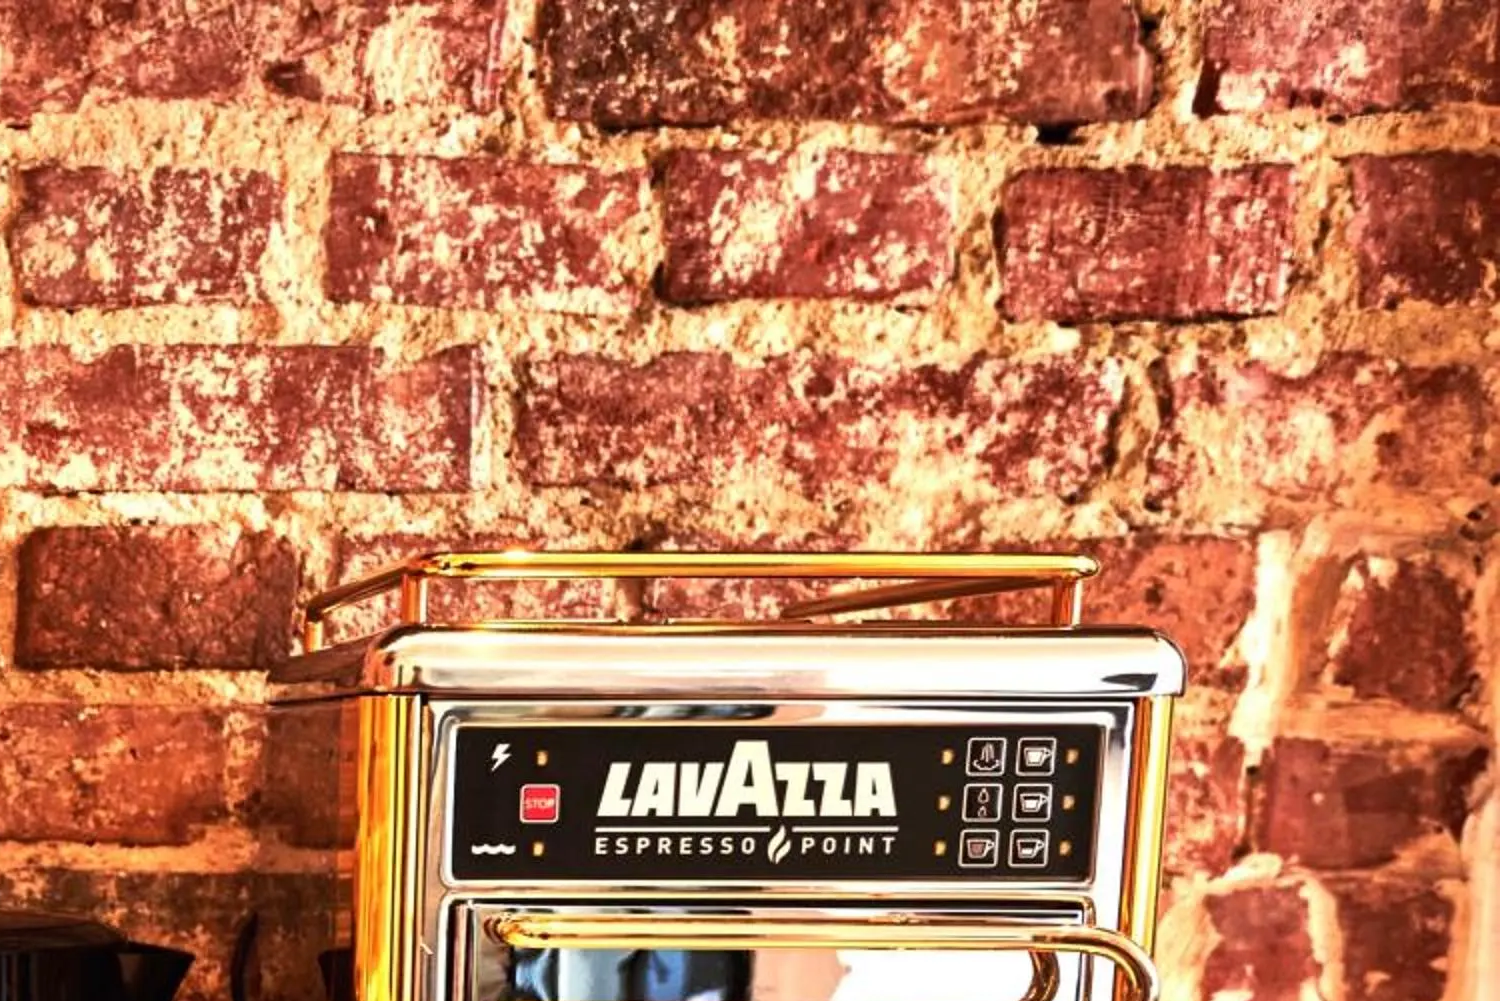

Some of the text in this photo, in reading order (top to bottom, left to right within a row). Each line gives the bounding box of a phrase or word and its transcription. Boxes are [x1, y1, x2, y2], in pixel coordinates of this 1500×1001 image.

[596, 740, 897, 817] LAVAZZA
[525, 797, 555, 809] STOP
[595, 837, 896, 855] ESPRESSO POINT
